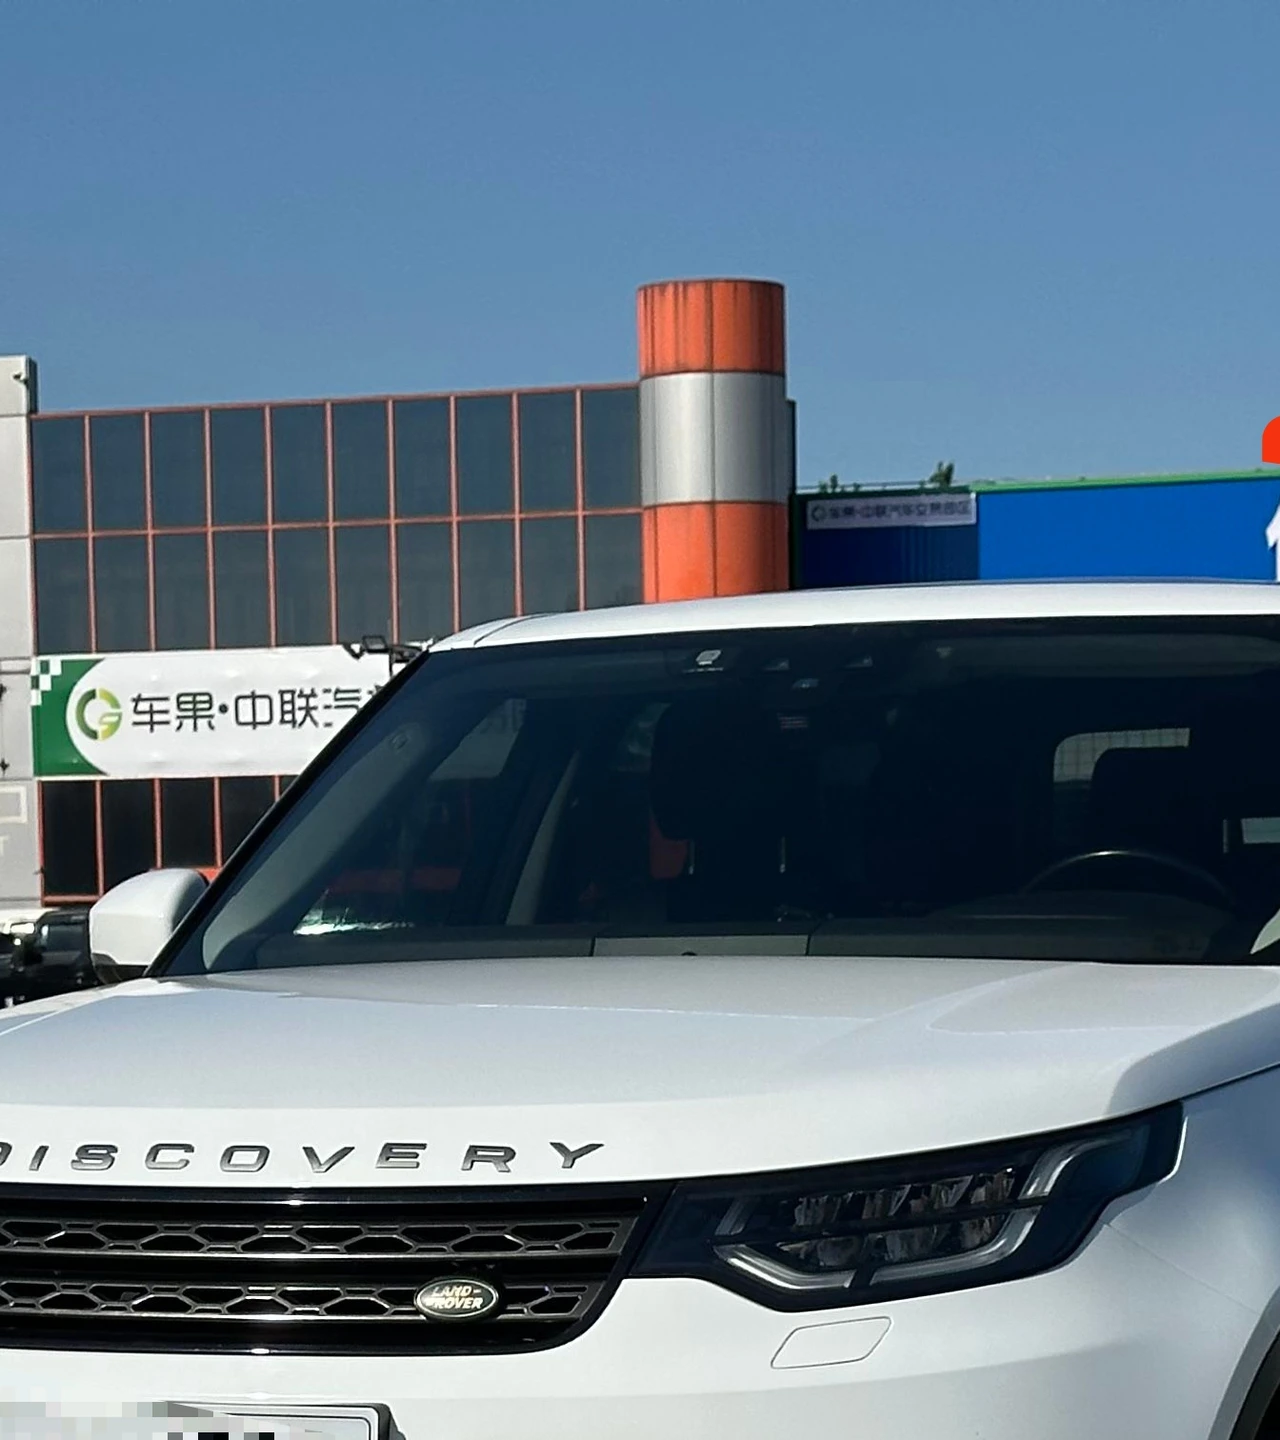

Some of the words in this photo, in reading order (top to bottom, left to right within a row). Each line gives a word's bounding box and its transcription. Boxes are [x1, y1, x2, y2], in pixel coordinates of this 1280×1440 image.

[131, 683, 384, 734] 车果·中联汽
